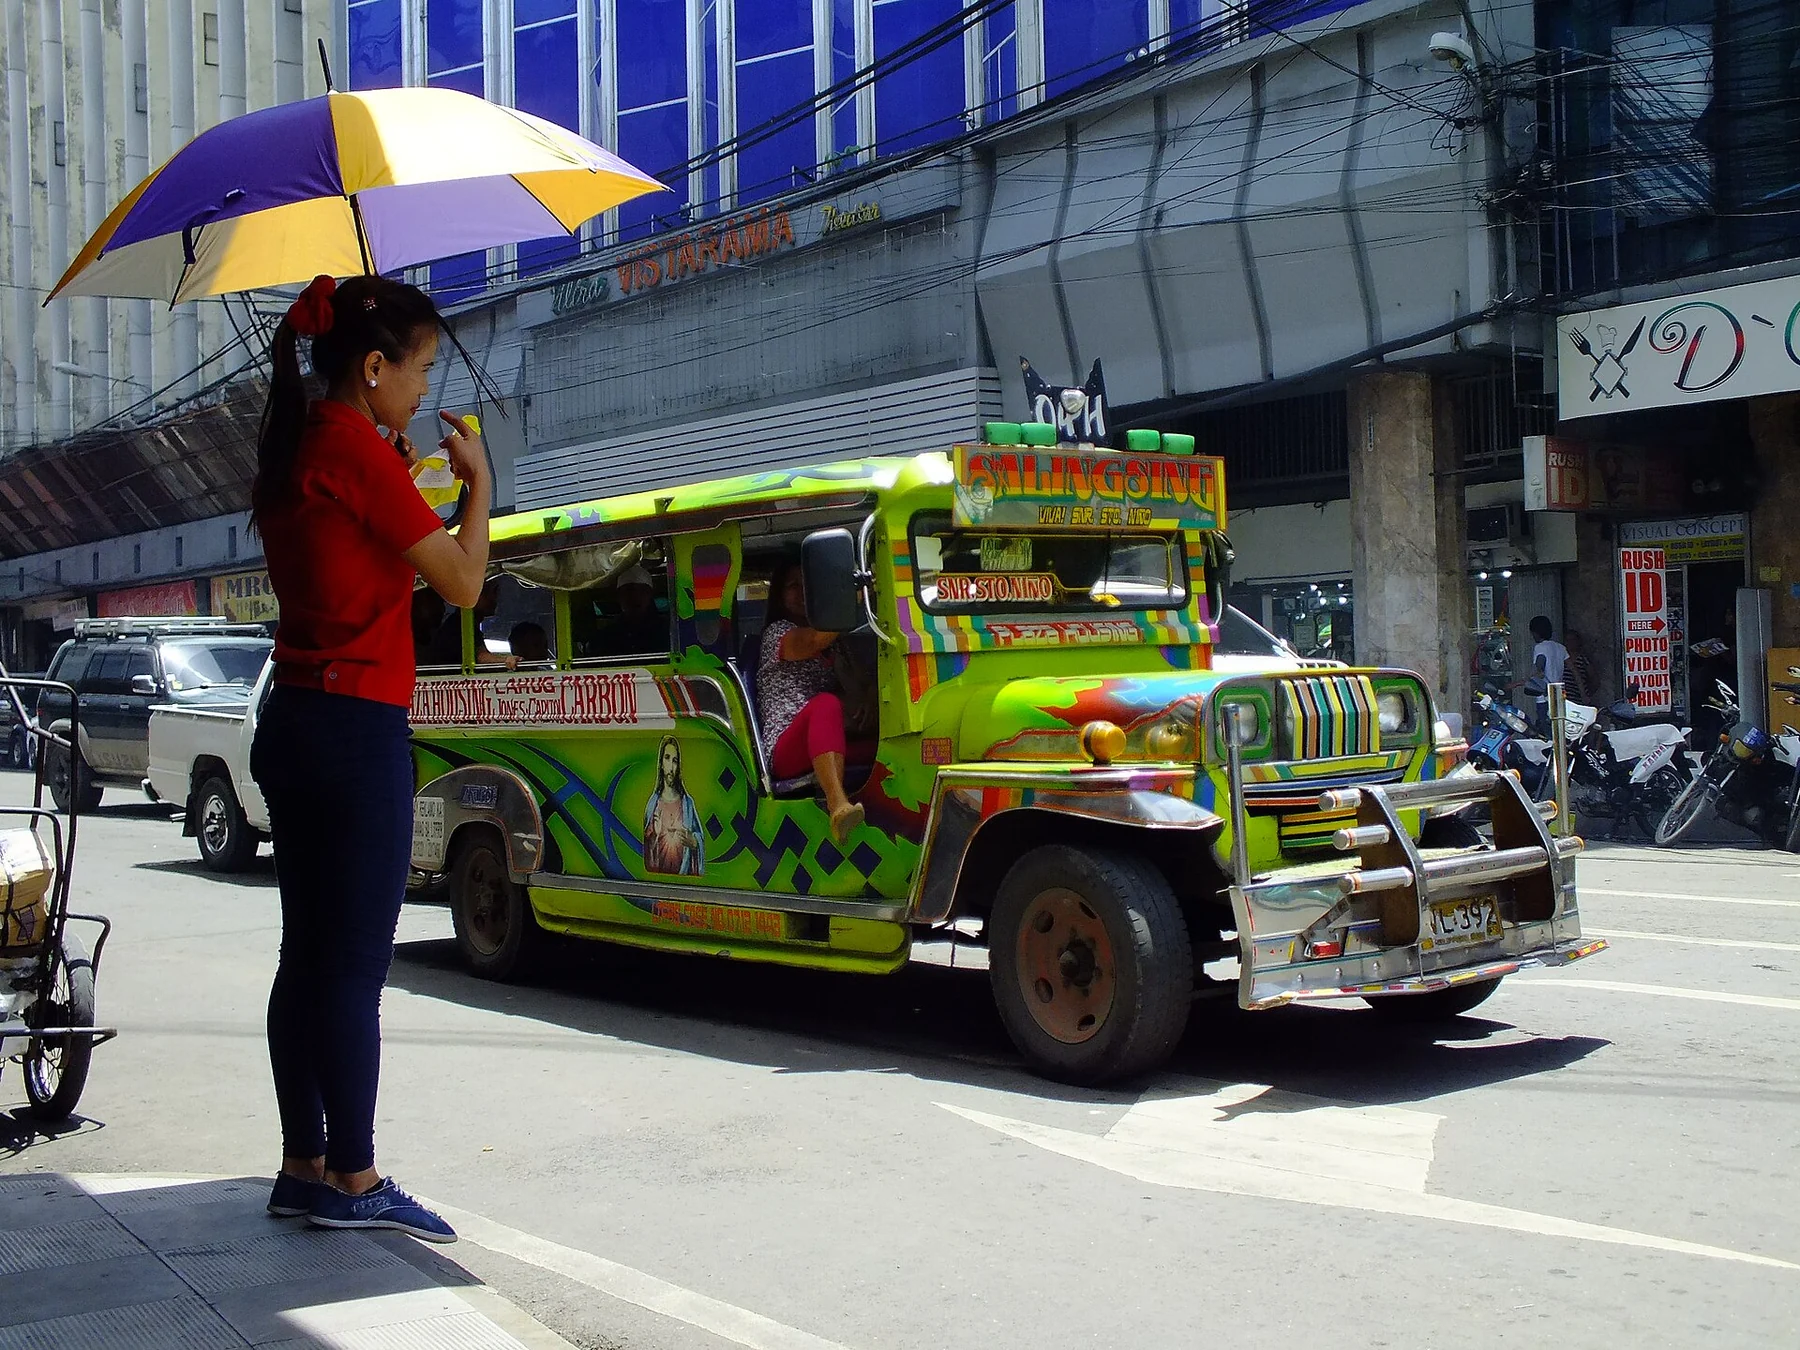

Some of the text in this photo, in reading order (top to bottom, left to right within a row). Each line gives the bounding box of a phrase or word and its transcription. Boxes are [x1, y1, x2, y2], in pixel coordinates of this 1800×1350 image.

[616, 202, 795, 295] VISTARAMA
[1548, 452, 1583, 468] RUSH
[1550, 468, 1586, 503] ID
[1622, 525, 1670, 540] VISUAL
[1622, 550, 1665, 570] RUSH
[1625, 572, 1662, 613] ID
[1631, 621, 1652, 630] HERE
[1626, 637, 1668, 653] PHOTO
[1627, 656, 1668, 672] VIDEO
[494, 676, 556, 694] LAHUG
[1627, 674, 1669, 688] LAYOUT
[560, 673, 638, 725] CARBON
